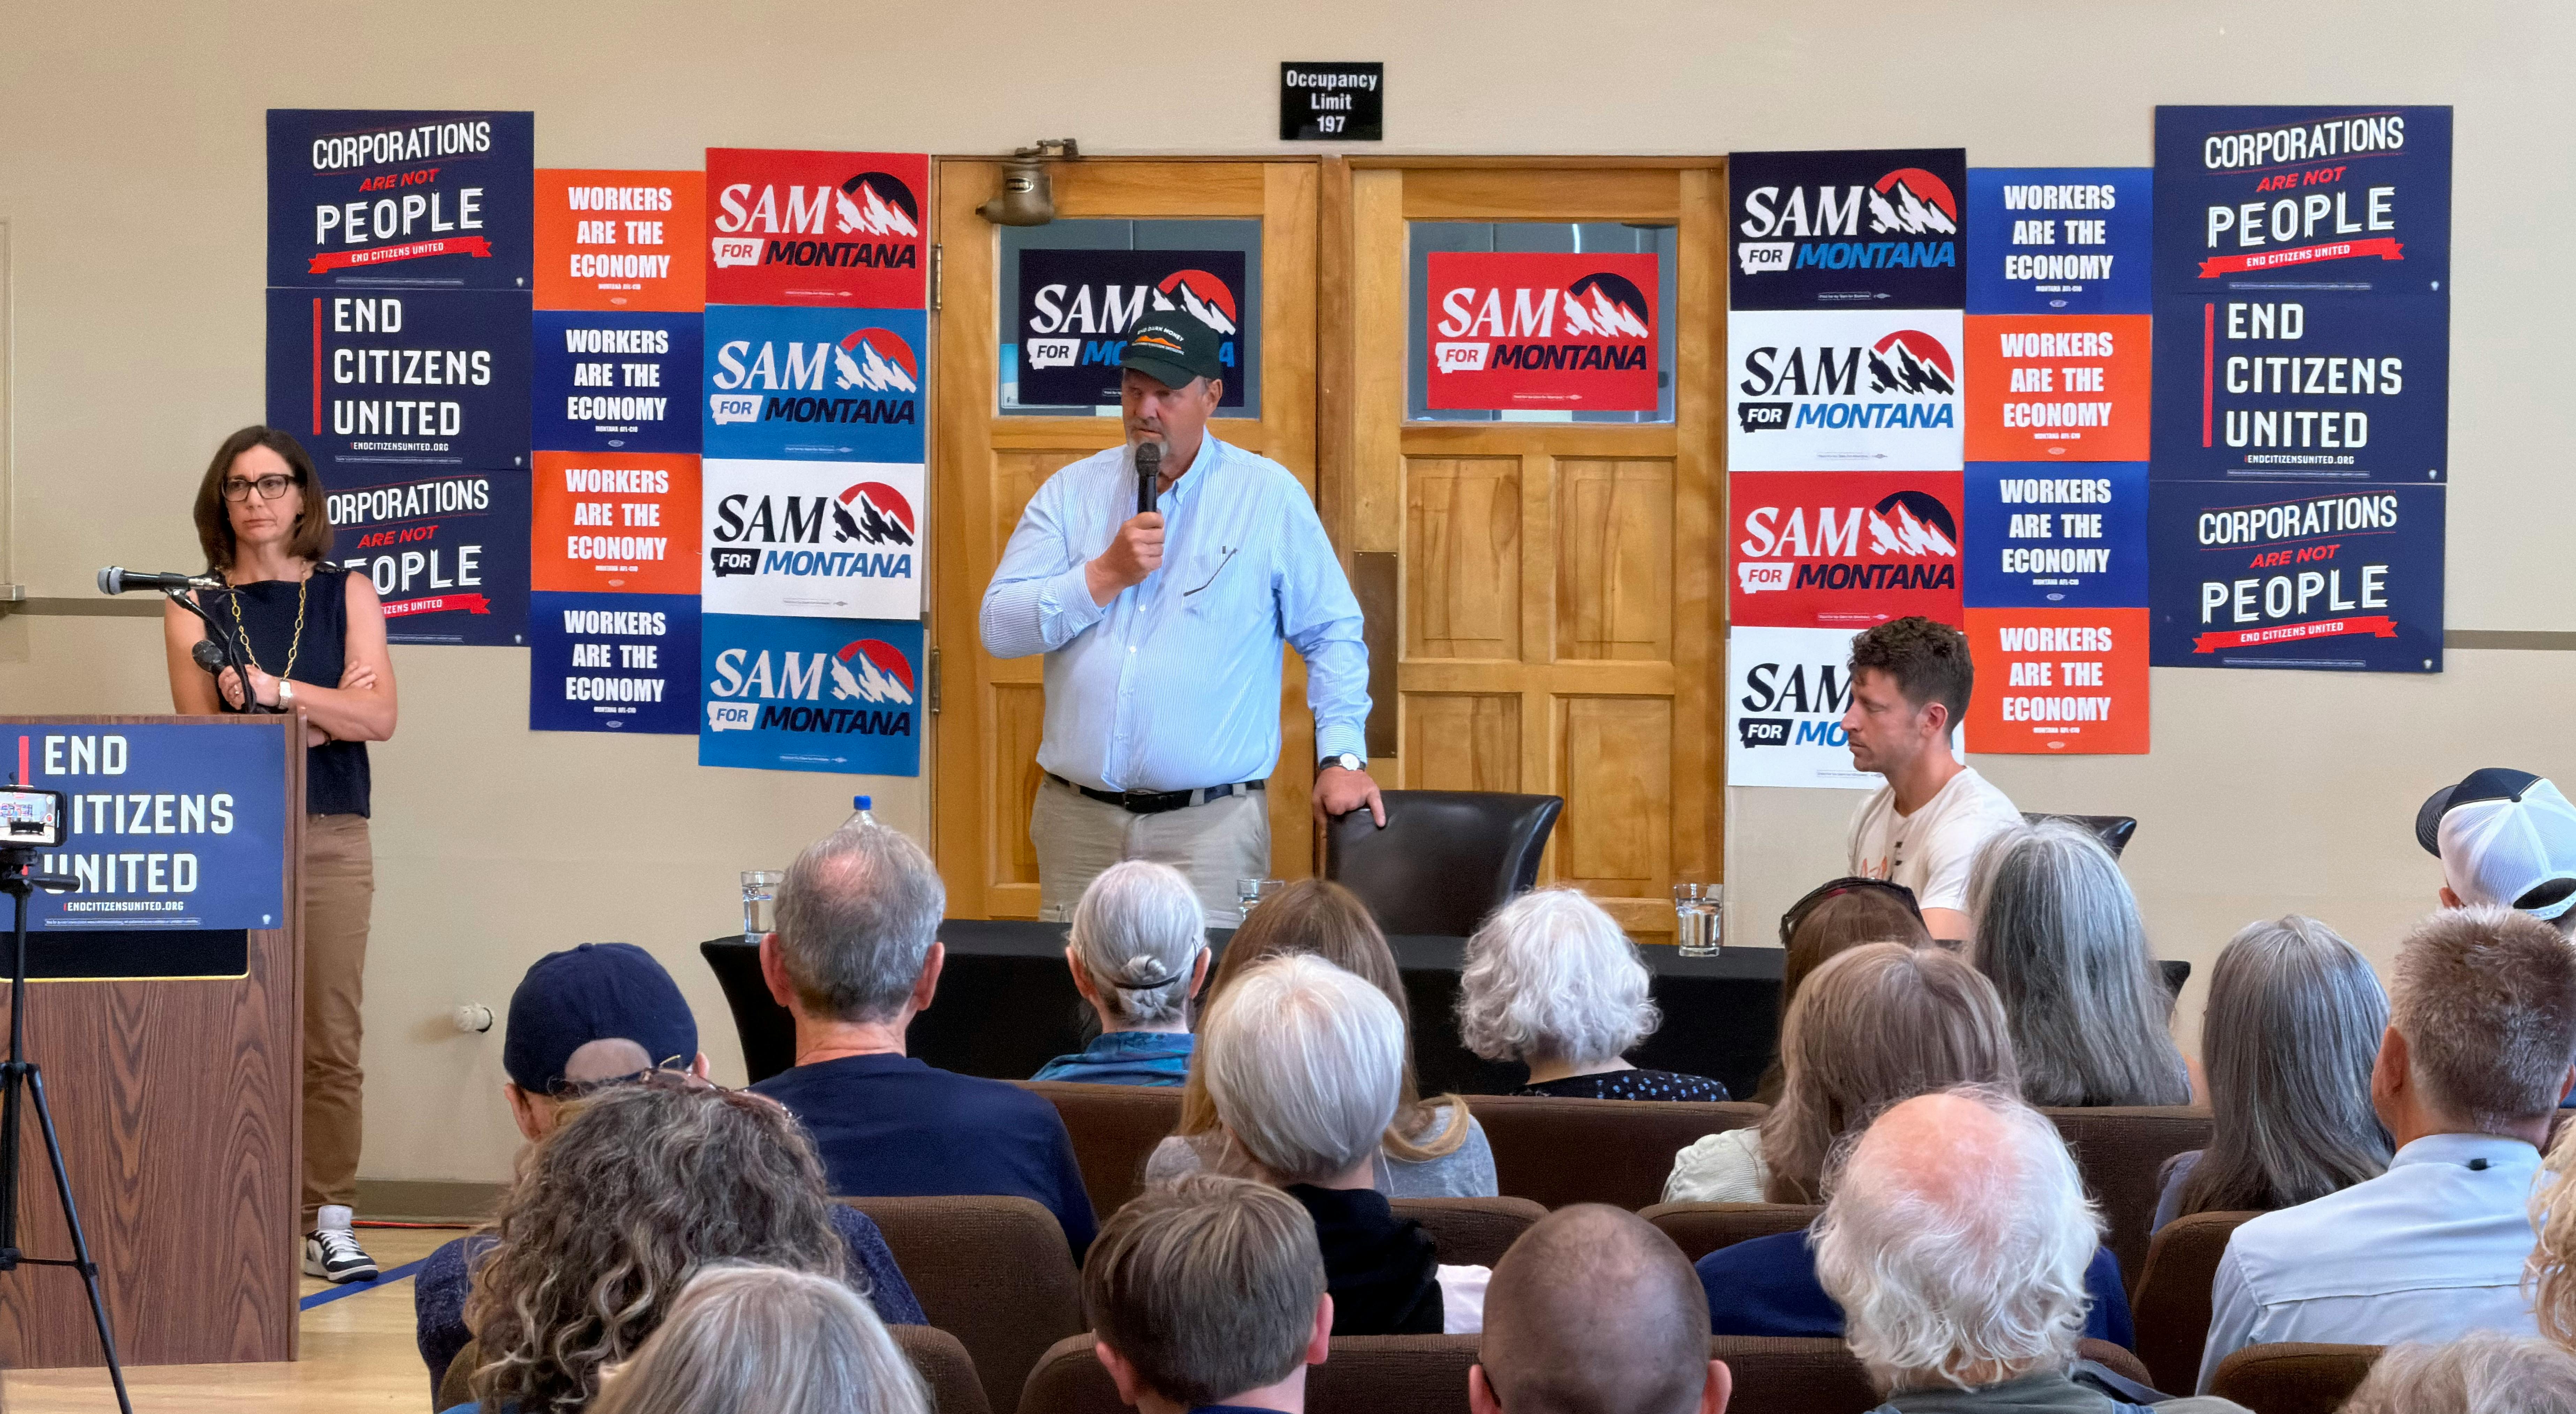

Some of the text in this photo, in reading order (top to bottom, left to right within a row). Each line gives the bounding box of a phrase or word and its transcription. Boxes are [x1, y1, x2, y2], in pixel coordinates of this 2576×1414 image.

[1287, 70, 1377, 91] Occupancy
[1311, 93, 1351, 109] Limit
[1317, 116, 1345, 132] 197
[314, 122, 490, 169] CORPORATIONS
[2206, 117, 2404, 168] CORPORATIONS
[360, 169, 439, 192] ARE NOT
[2257, 167, 2346, 191] ARE NOT
[568, 187, 672, 211] WORKERS
[715, 184, 831, 234] SAM
[2004, 185, 2115, 209] WORKERS
[317, 188, 483, 245] PEOPLE
[1741, 186, 1865, 237] SAM
[2208, 187, 2395, 248] PEOPLE
[577, 221, 663, 244] ARE THE
[2013, 220, 2105, 244] ARE THE
[352, 242, 443, 262] END CITIZENS UNITED
[722, 241, 915, 269] FOR MONTANA
[1749, 242, 1955, 269] FOR MONTANA
[2247, 245, 2350, 267] END CITIZENS UNITED
[571, 254, 670, 278] ECONOMY
[2006, 255, 2114, 279] ECONOMY
[335, 299, 401, 332] END
[1030, 284, 1148, 333] SAM
[1438, 288, 1559, 337] SAM
[2229, 304, 2303, 339] END
[566, 330, 668, 353] WORKERS
[1163, 328, 1184, 341] MONEY
[2001, 332, 2113, 357] WORKERS
[1037, 345, 1069, 358] FOR
[1445, 344, 1647, 370] FOR MONTANA
[334, 349, 490, 385] CITIZENS
[574, 364, 659, 387] ARE THE
[713, 341, 830, 390] SAM
[1741, 347, 1862, 396] SAM
[2227, 357, 2402, 394] CITIZENS
[2011, 368, 2104, 392] ARE THE
[334, 401, 459, 435] UNITED
[568, 397, 666, 420] ECONOMY
[720, 397, 914, 424] FOR MONTANA
[1748, 403, 1953, 428] FOR MONTANA
[2004, 403, 2112, 427] ECONOMY
[2227, 411, 2367, 447] UNITED
[354, 442, 448, 451] ENDCITIZENSUNITED.ORG
[2248, 455, 2354, 464] ENDCITIZENSUNITED.ORG
[565, 469, 668, 493] WORKERS
[2000, 479, 2111, 503] WORKERS
[327, 480, 488, 524] ORPORATIONS
[574, 503, 660, 526] ARE THE
[713, 494, 828, 543] SAM
[2010, 514, 2102, 538] ARE THE
[2199, 496, 2397, 544] CORPORATIONS
[358, 526, 438, 548] ARE NOT
[1741, 507, 1864, 557] SAM
[568, 536, 667, 560] ECONOMY
[2251, 545, 2340, 568] ARE NOT
[325, 546, 482, 595] OPLE
[720, 551, 911, 578] FOR MONTANA
[2003, 549, 2110, 573] ECONOMY
[1749, 564, 1954, 589] FOR MONTANA
[2203, 565, 2388, 624] PEOPLE
[382, 599, 442, 615] IZENS UNITED
[564, 611, 666, 635] WORKERS
[2241, 622, 2343, 642] END CITIZENS UNITED
[2000, 627, 2112, 651] WORKERS
[573, 644, 657, 668] ARE THE
[710, 648, 827, 700] SAM
[2010, 663, 2103, 686] ARE THE
[566, 677, 664, 702] ECONOMY
[717, 706, 910, 736] FOR MONTANA
[2003, 697, 2111, 721] ECONOMY
[1748, 724, 1783, 738] FOR
[45, 736, 127, 774] END
[74, 794, 233, 833] ITIZENS
[68, 901, 183, 911] ENDCITIZENSUNITED.ORG
